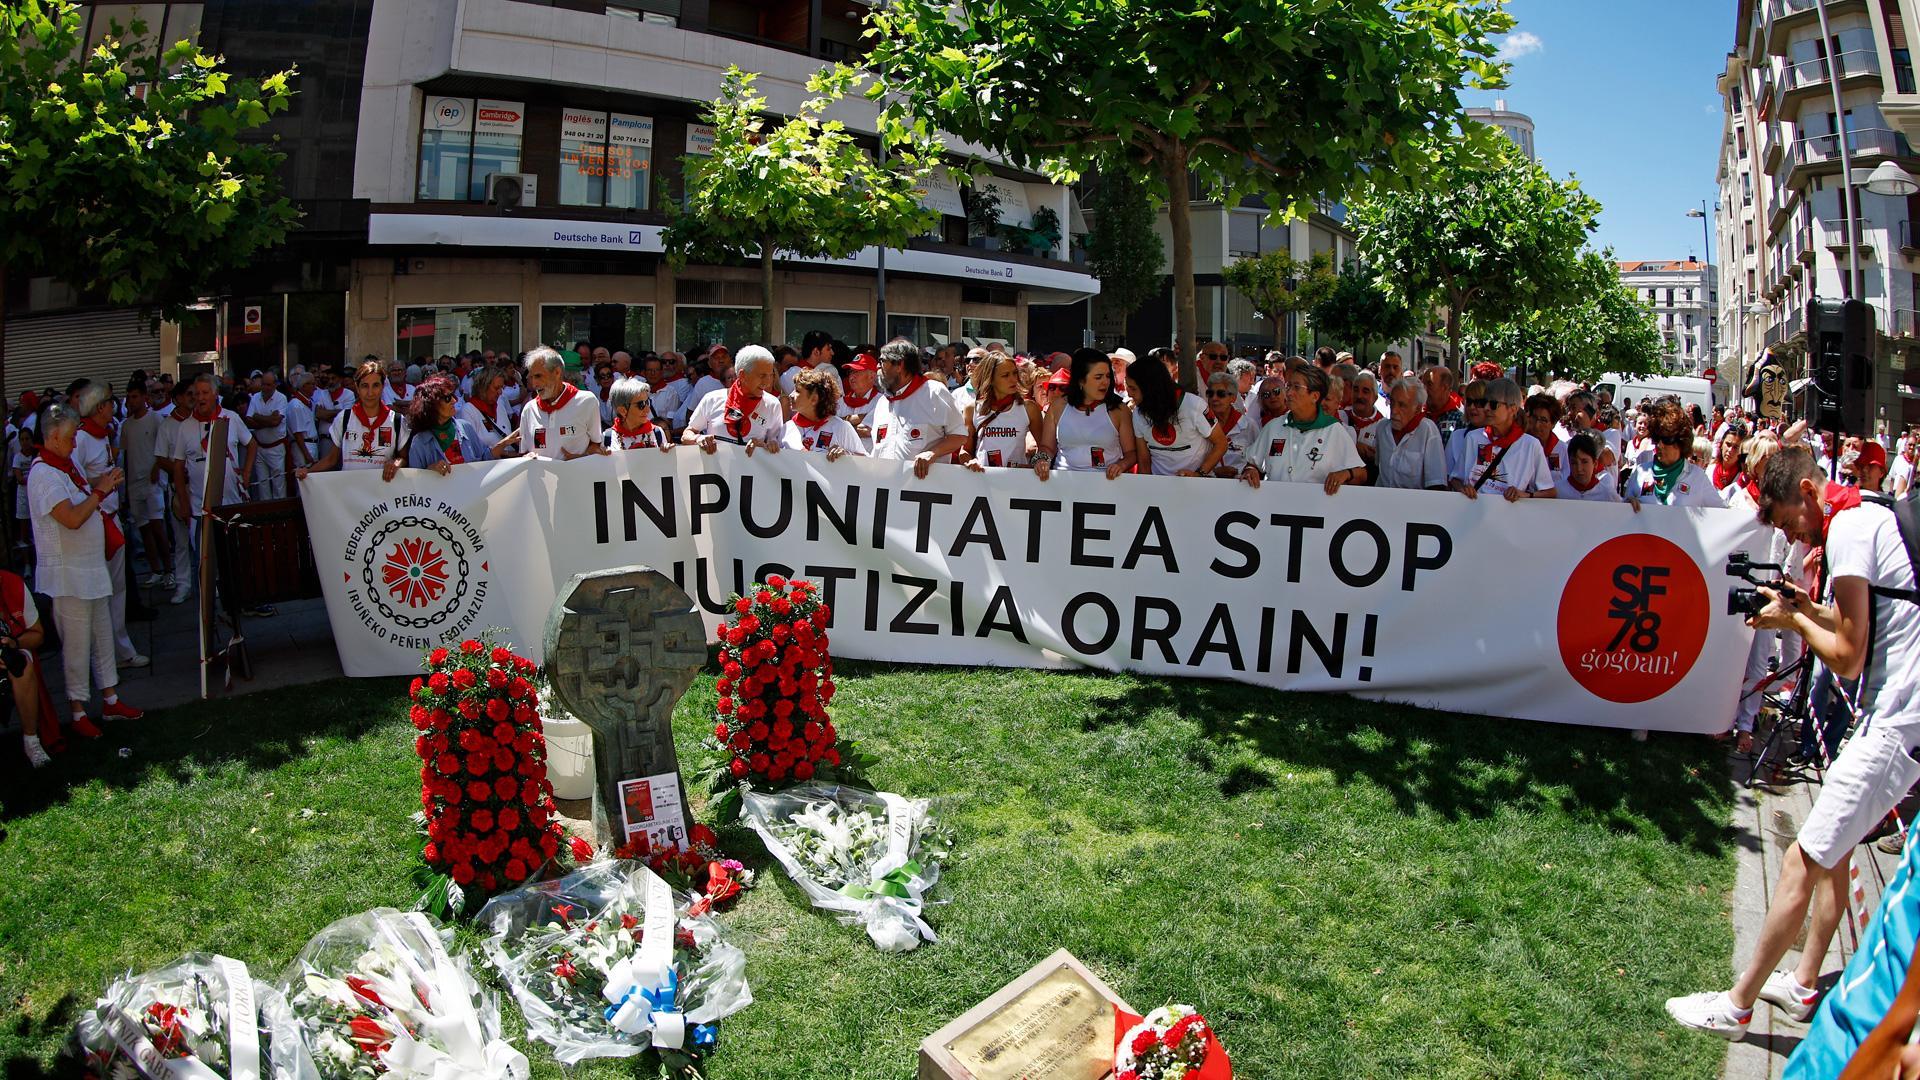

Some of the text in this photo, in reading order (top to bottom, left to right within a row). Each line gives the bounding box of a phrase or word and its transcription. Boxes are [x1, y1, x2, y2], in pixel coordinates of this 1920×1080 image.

[440, 105, 460, 119] iep
[480, 110, 515, 121] Cambridge
[564, 113, 592, 124] Inglés
[611, 117, 652, 129] Pamplona
[579, 144, 633, 158] CURSOS
[564, 152, 649, 169] INTENSIVOS
[578, 165, 633, 178] AGOSTO
[554, 232, 624, 244] Deutsche Bank
[965, 265, 1003, 277] Deutsche Bank
[345, 493, 484, 562] FEDERACIÓN PEÑAS PAMPLONA
[593, 473, 1453, 592] INPUNITATEA STOP
[1609, 564, 1671, 612] SF
[347, 580, 488, 648] IRUÑEKO PEÑEN FEDERAZIOA
[1060, 590, 1379, 683] ORAIN!
[1606, 608, 1662, 654] 78
[1580, 648, 1679, 676] gogoan!
